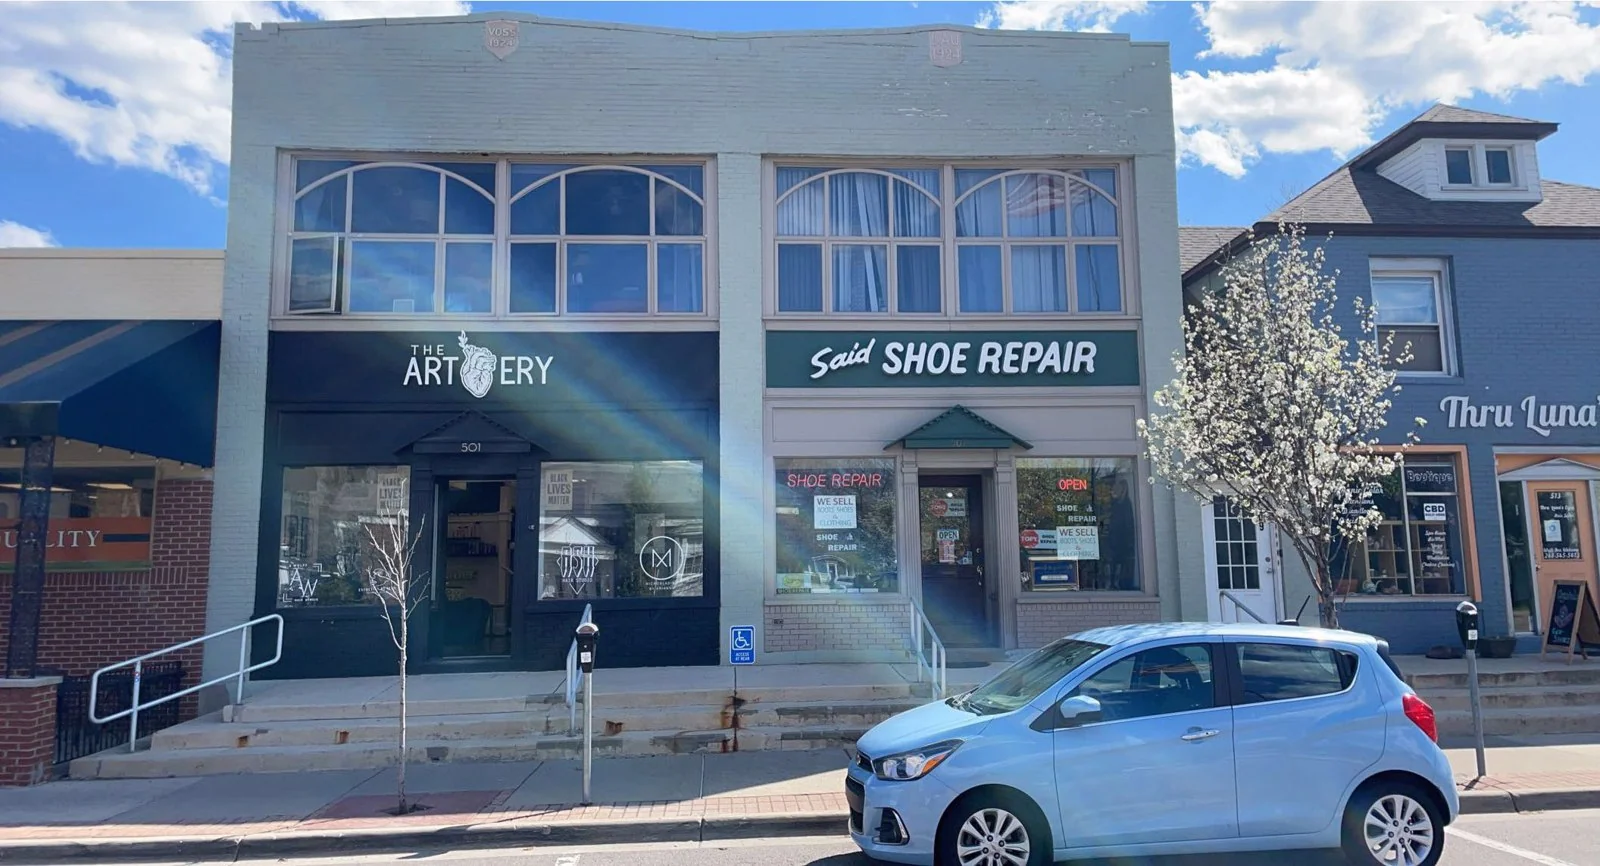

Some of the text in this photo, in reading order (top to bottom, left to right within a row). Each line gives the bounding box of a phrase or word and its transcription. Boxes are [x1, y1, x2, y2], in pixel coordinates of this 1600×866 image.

[489, 28, 516, 36] VOSS
[488, 39, 515, 47] 1924
[410, 344, 445, 356] THE
[810, 338, 1097, 379] Said SHOE REPAIR
[1439, 395, 1514, 428] Thru
[460, 442, 481, 453] 501
[786, 473, 882, 488] SHOE REPAIR
[1406, 470, 1454, 484] Boutique
[547, 483, 571, 495] LIVES
[1058, 479, 1088, 491] OPEN
[548, 495, 570, 505] MATTER
[816, 497, 854, 506] WE SELL
[1056, 504, 1079, 512] SHOE
[1424, 505, 1445, 513] CBD
[1067, 515, 1098, 523] REPAIR
[816, 533, 839, 541] SHOE
[938, 531, 958, 540] OPEN
[1060, 528, 1096, 537] WE SELL
[827, 544, 858, 552] REPAIR
